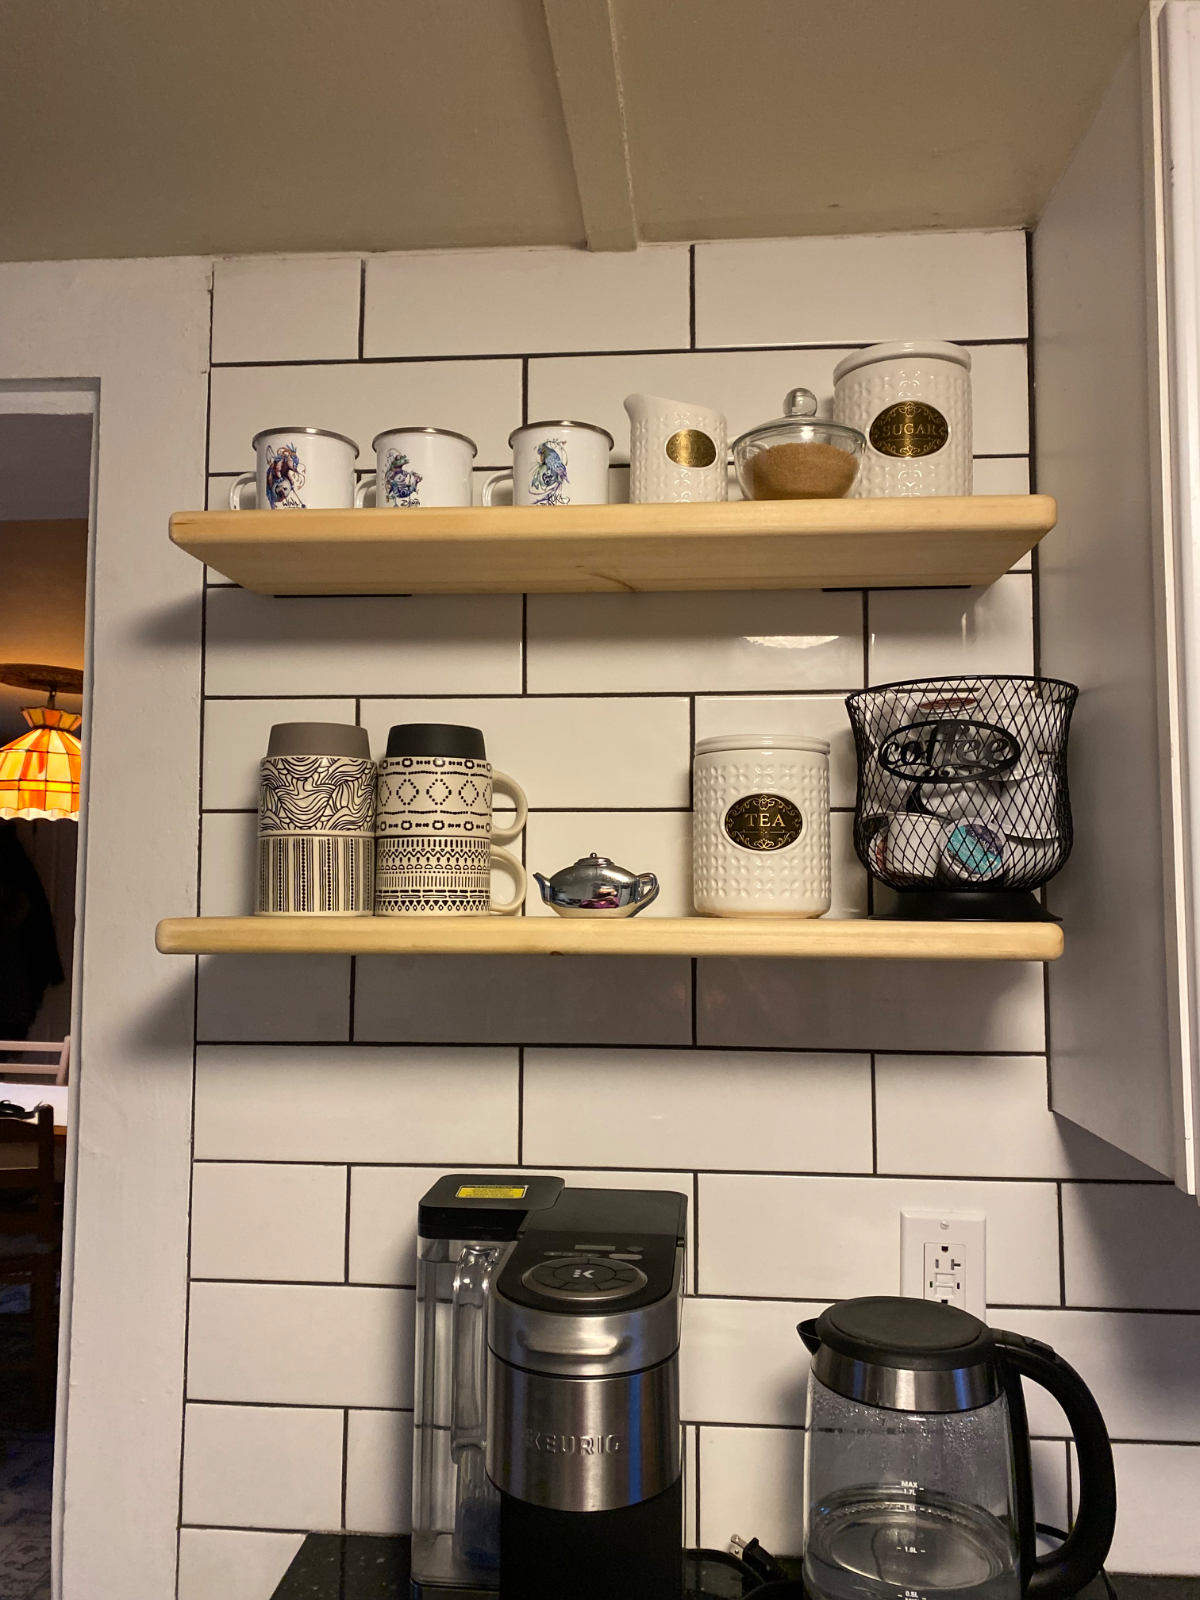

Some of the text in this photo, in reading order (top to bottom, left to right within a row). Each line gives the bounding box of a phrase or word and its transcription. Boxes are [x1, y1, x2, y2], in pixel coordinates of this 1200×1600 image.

[883, 423, 938, 436] SUGAR
[881, 723, 1013, 766] coffee
[744, 813, 786, 827] TEA
[528, 1430, 621, 1455] KEURIG
[901, 1480, 918, 1488] MAX
